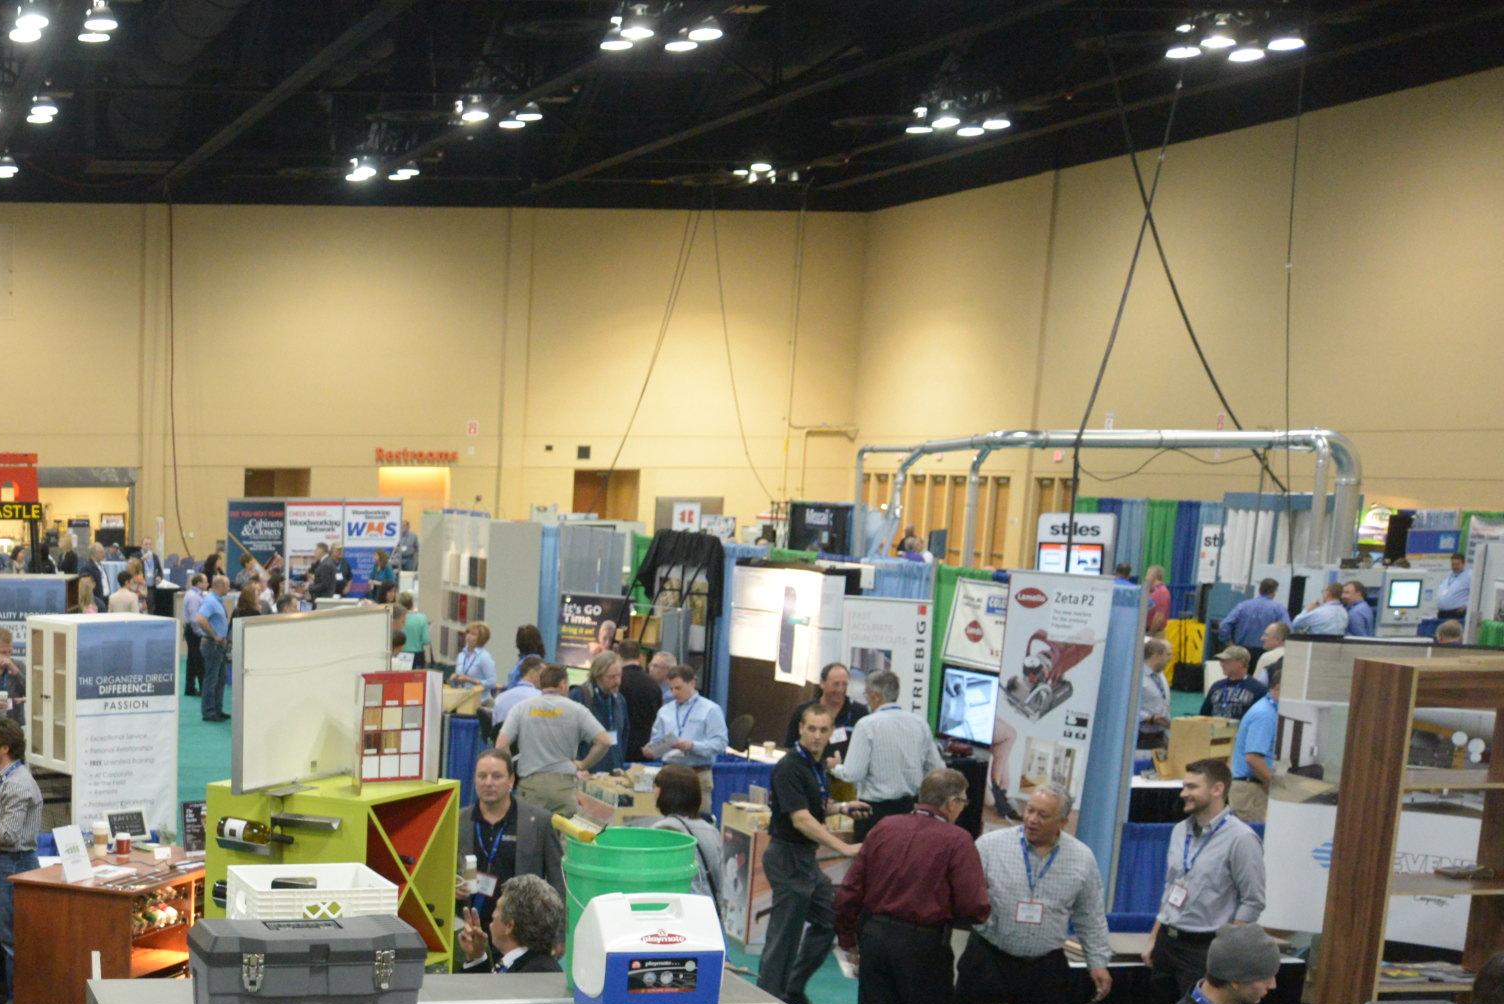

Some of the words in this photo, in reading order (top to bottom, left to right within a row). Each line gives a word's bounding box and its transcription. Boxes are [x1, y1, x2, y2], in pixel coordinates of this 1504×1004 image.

[347, 522, 397, 537] WMS
[1050, 522, 1101, 536] stles
[1054, 592, 1079, 605] Zeta
[1081, 594, 1094, 606] P2
[584, 604, 602, 616] GO
[912, 621, 927, 713] TRIEBIG
[79, 677, 93, 686] THE
[96, 675, 144, 685] ORGANIZER
[146, 674, 173, 683] DIRECT
[104, 700, 149, 711] PASSION
[643, 934, 686, 943] playmate
